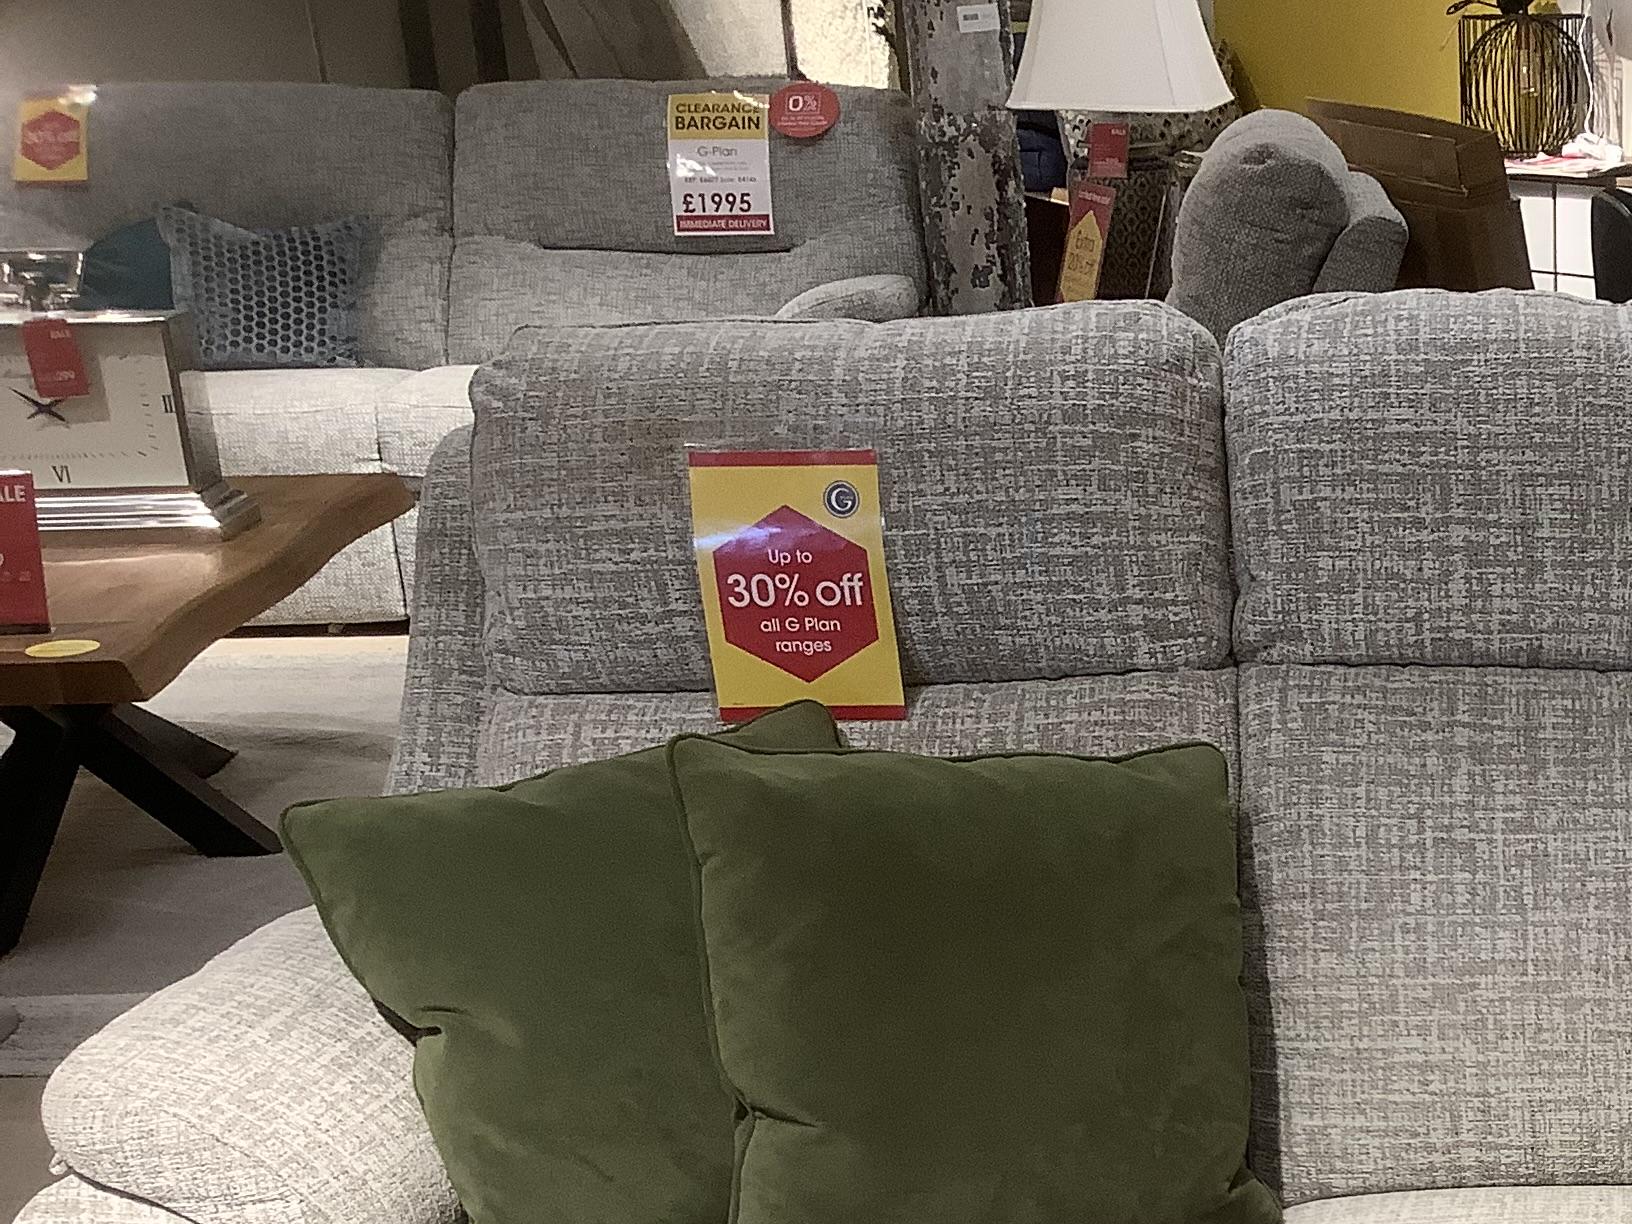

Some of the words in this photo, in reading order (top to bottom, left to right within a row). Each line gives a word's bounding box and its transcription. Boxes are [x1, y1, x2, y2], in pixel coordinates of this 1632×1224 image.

[675, 116, 760, 130] BARGAIN
[697, 146, 738, 158] G-Plan
[682, 193, 752, 214] £1995
[680, 220, 726, 230] IMMEDIATE
[729, 218, 767, 229] DELIVERY
[52, 465, 71, 483] VI
[767, 549, 791, 566] Up
[796, 549, 813, 564] to
[727, 573, 810, 608] 30%
[815, 572, 864, 607] off
[760, 618, 781, 632] all
[785, 617, 800, 632] G
[804, 617, 841, 632] Plan
[775, 640, 832, 656] ranges
